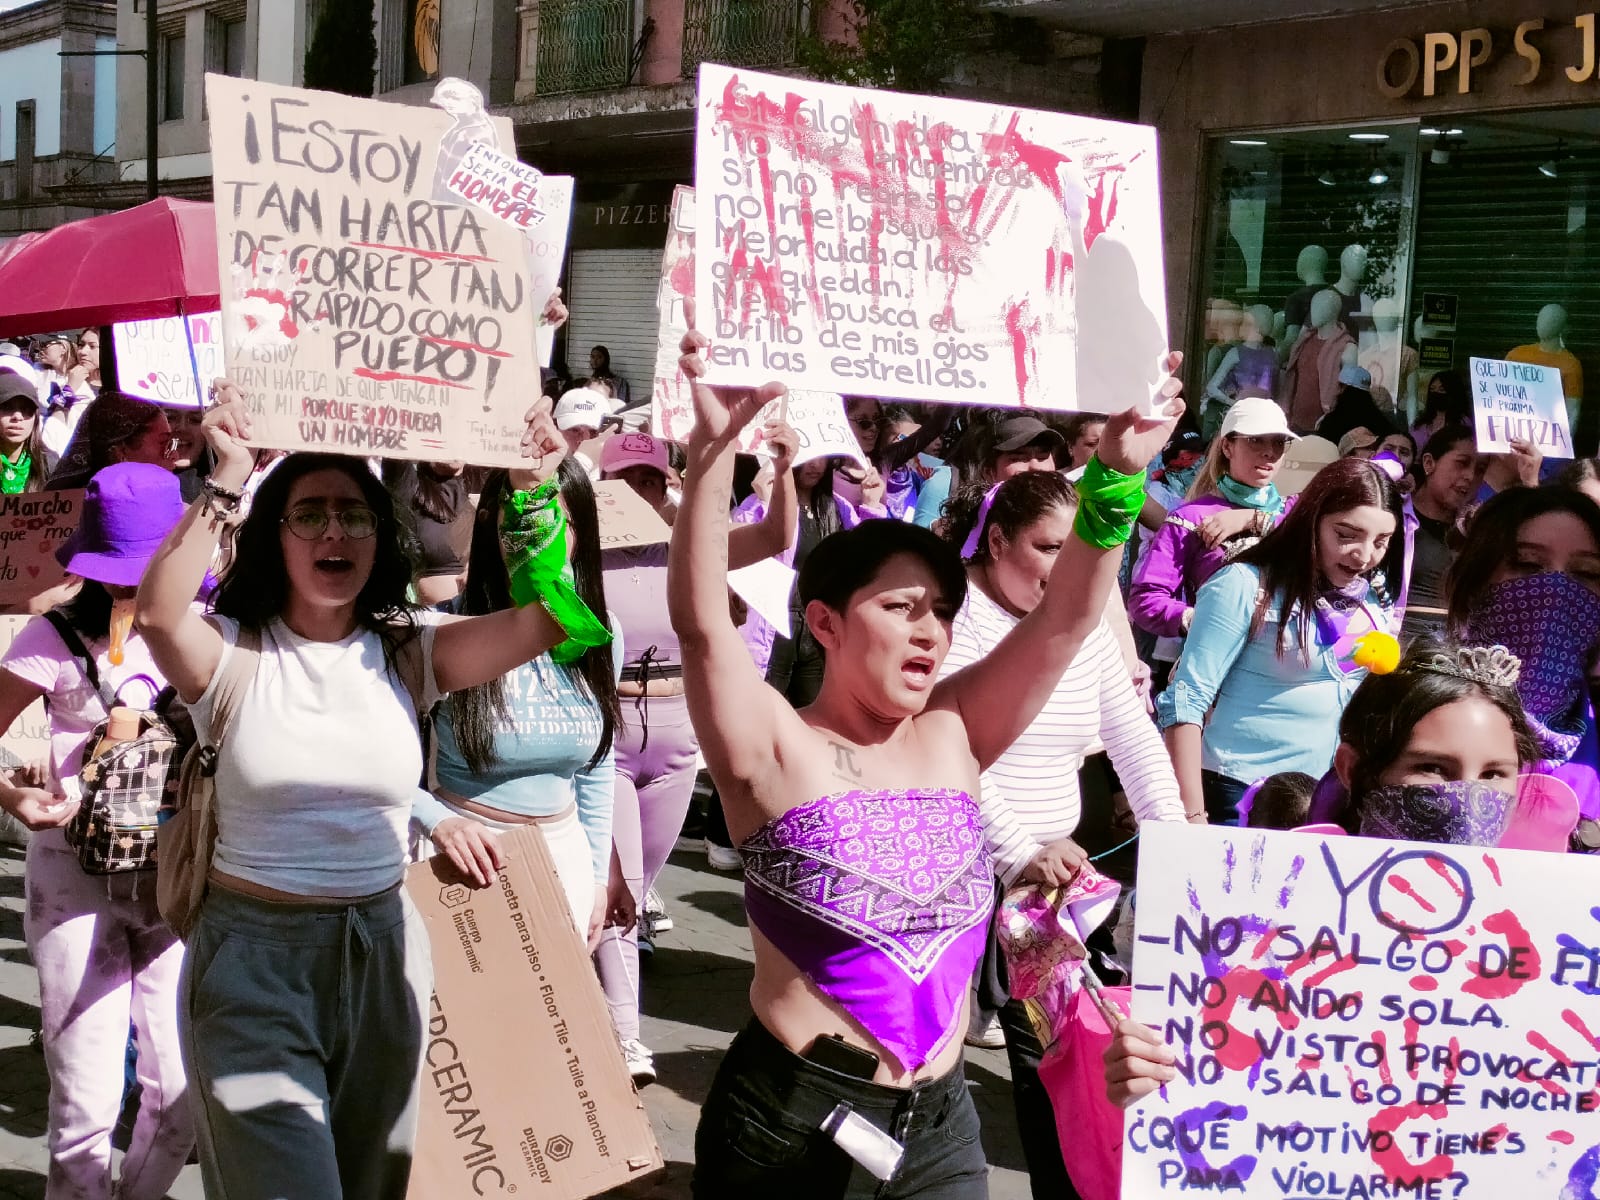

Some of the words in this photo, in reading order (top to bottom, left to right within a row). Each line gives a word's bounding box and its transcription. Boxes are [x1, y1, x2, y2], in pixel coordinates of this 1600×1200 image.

[723, 124, 771, 159] no
[511, 181, 539, 207] EL
[771, 166, 817, 198] no
[222, 181, 323, 236] TAN
[340, 193, 488, 257] HARTA
[714, 193, 762, 220] no
[779, 201, 834, 230] me
[714, 215, 806, 263] Mejor
[814, 235, 888, 267] cuida
[893, 249, 918, 271] a
[290, 244, 433, 304] CORRER
[442, 261, 524, 314] TAN
[711, 281, 807, 321] Mejor
[824, 292, 919, 329] busca
[928, 312, 965, 334] el
[408, 308, 502, 351] COMO
[716, 308, 804, 345] brillo
[818, 321, 862, 351] de
[872, 330, 920, 356] mis
[932, 336, 990, 368] ojos
[252, 343, 298, 367] ESTOY
[711, 344, 750, 368] en
[761, 341, 808, 373] las
[830, 352, 988, 388] estrellas.
[1475, 360, 1496, 378] QUE
[1512, 363, 1545, 383] MIEDO
[232, 366, 267, 388] TAN
[274, 367, 328, 393] HARTA
[336, 375, 353, 397] DE
[358, 379, 388, 401] QUE
[391, 380, 450, 407] VENGAN
[1479, 380, 1489, 394] SE
[1495, 383, 1528, 400] VUELVA
[302, 396, 359, 421] PORQUE
[400, 408, 442, 434] FUERA
[1487, 415, 1567, 449] FUERZA
[299, 420, 327, 442] UN
[333, 423, 408, 450] HOMBRE
[497, 865, 520, 911] Loseta
[1319, 839, 1476, 936] YO
[463, 908, 482, 944] Cuerpo
[510, 911, 532, 943] para
[522, 943, 543, 973] piso
[1273, 925, 1454, 974] SALGO
[1479, 943, 1531, 979] DE
[539, 983, 561, 1020] Floor
[1247, 979, 1365, 1022] ANDO
[1378, 994, 1510, 1029] SOLA.
[552, 1019, 569, 1046] Tile
[566, 1055, 586, 1089] Tuile
[1261, 1066, 1402, 1106] SALGO
[1416, 1081, 1466, 1107] DE
[577, 1089, 589, 1100] a
[582, 1100, 611, 1159] Plancher
[519, 1140, 539, 1178] CERAMIC
[522, 1127, 553, 1185] DURABODY
[1157, 1159, 1247, 1195] PARA
